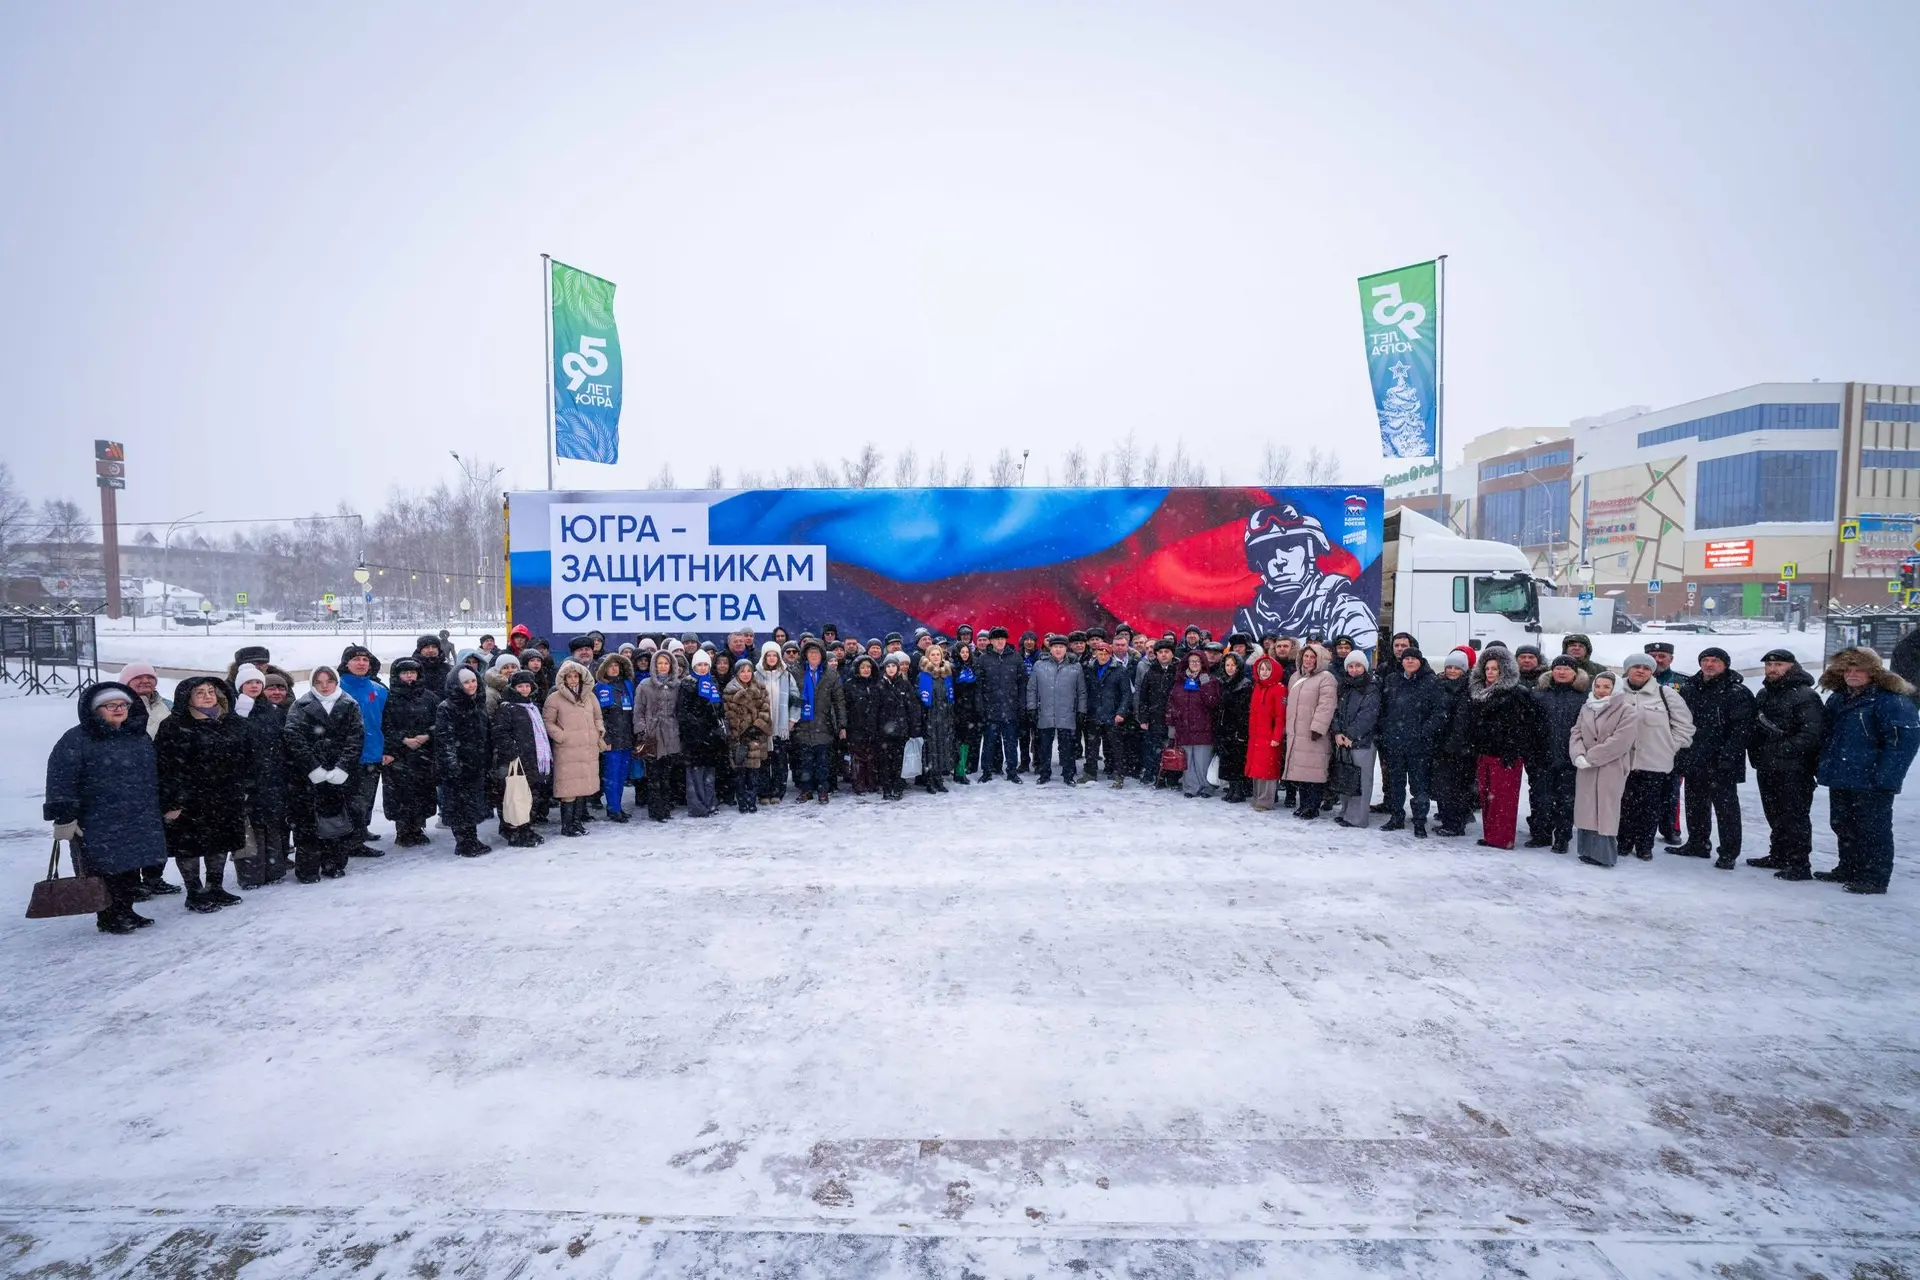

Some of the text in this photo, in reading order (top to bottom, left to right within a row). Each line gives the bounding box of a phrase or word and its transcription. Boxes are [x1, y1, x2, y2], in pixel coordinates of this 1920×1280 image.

[575, 393, 614, 409] ЮГРА
[585, 383, 613, 397] ЛЕТ
[1383, 460, 1442, 488] Green Park
[560, 514, 660, 543] ЮГРА
[560, 553, 814, 587] ЗАЩИТНИКАМ
[561, 593, 766, 622] ОТЕЧЕСТВА
